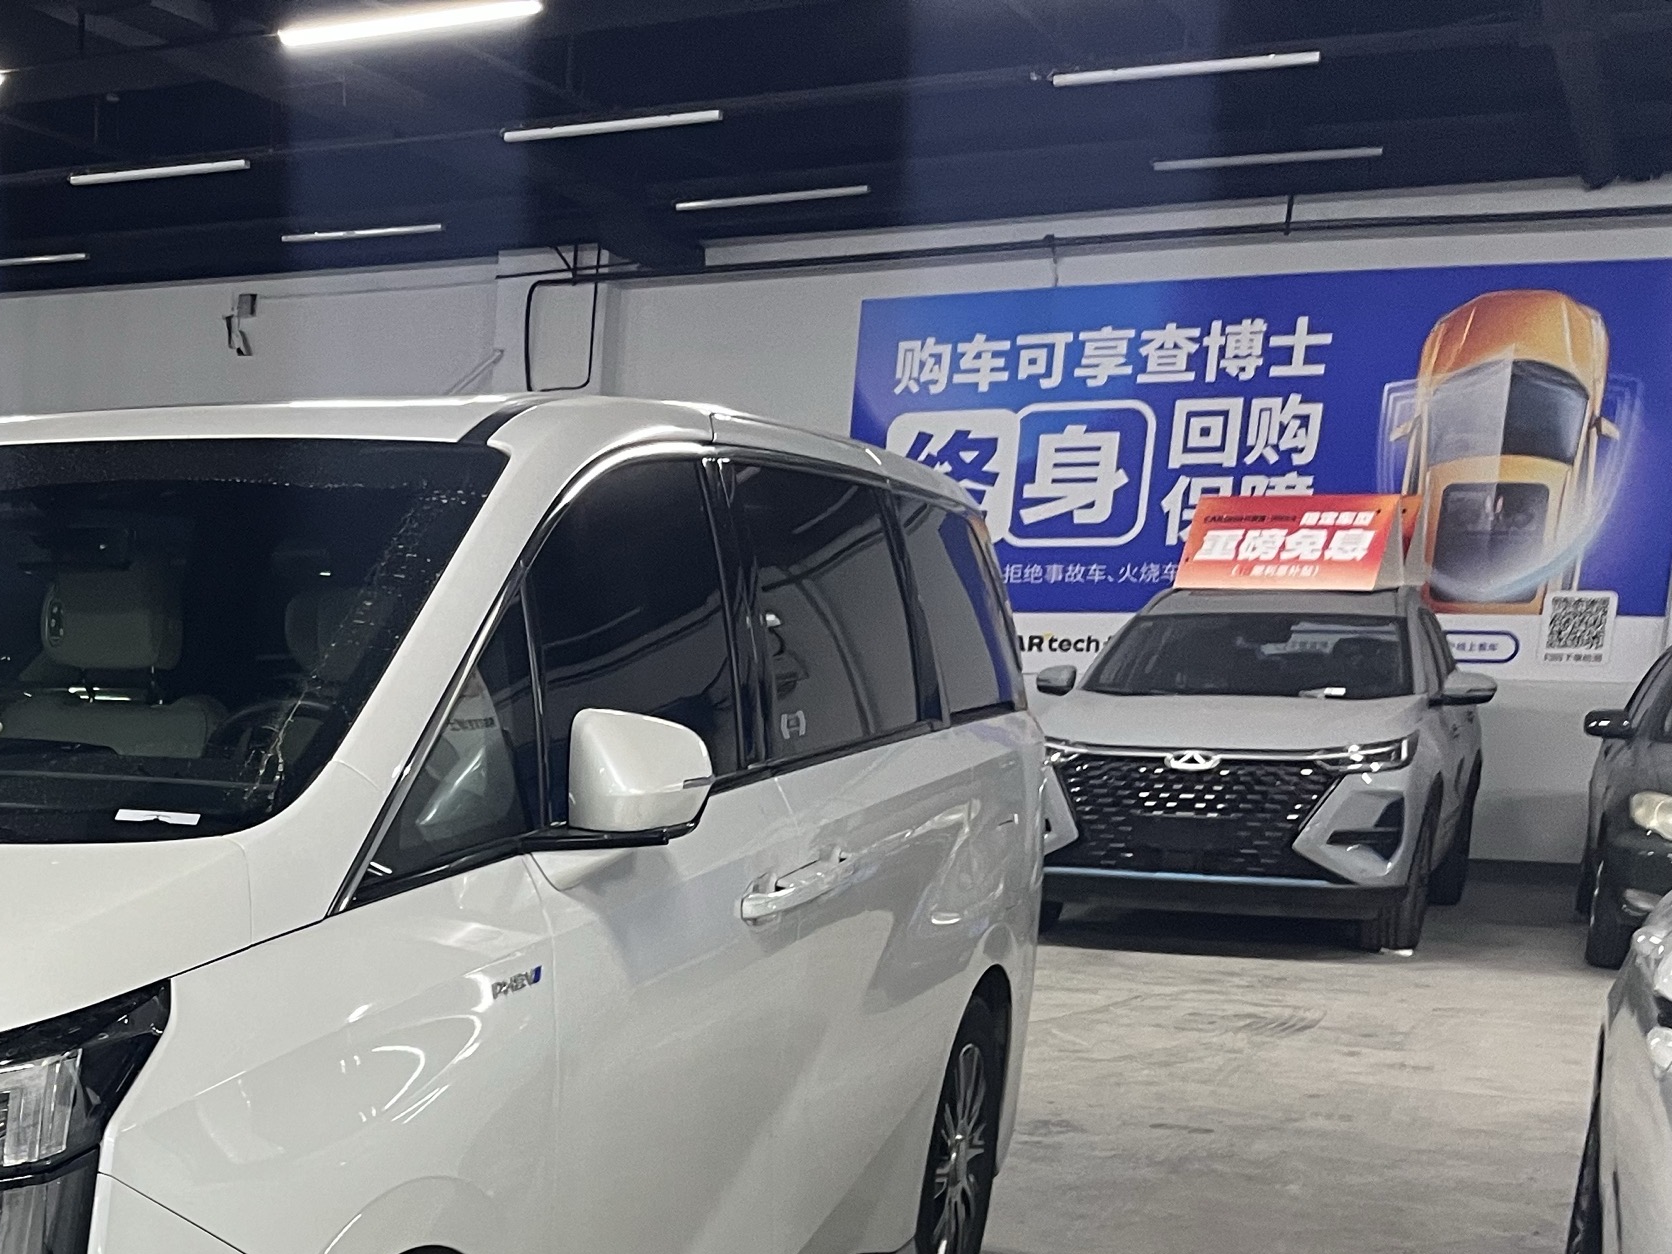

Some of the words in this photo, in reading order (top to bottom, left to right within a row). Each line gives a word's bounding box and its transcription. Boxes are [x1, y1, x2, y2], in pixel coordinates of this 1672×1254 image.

[893, 315, 1333, 395] 购车可享查博士
[1168, 393, 1324, 469] 回购
